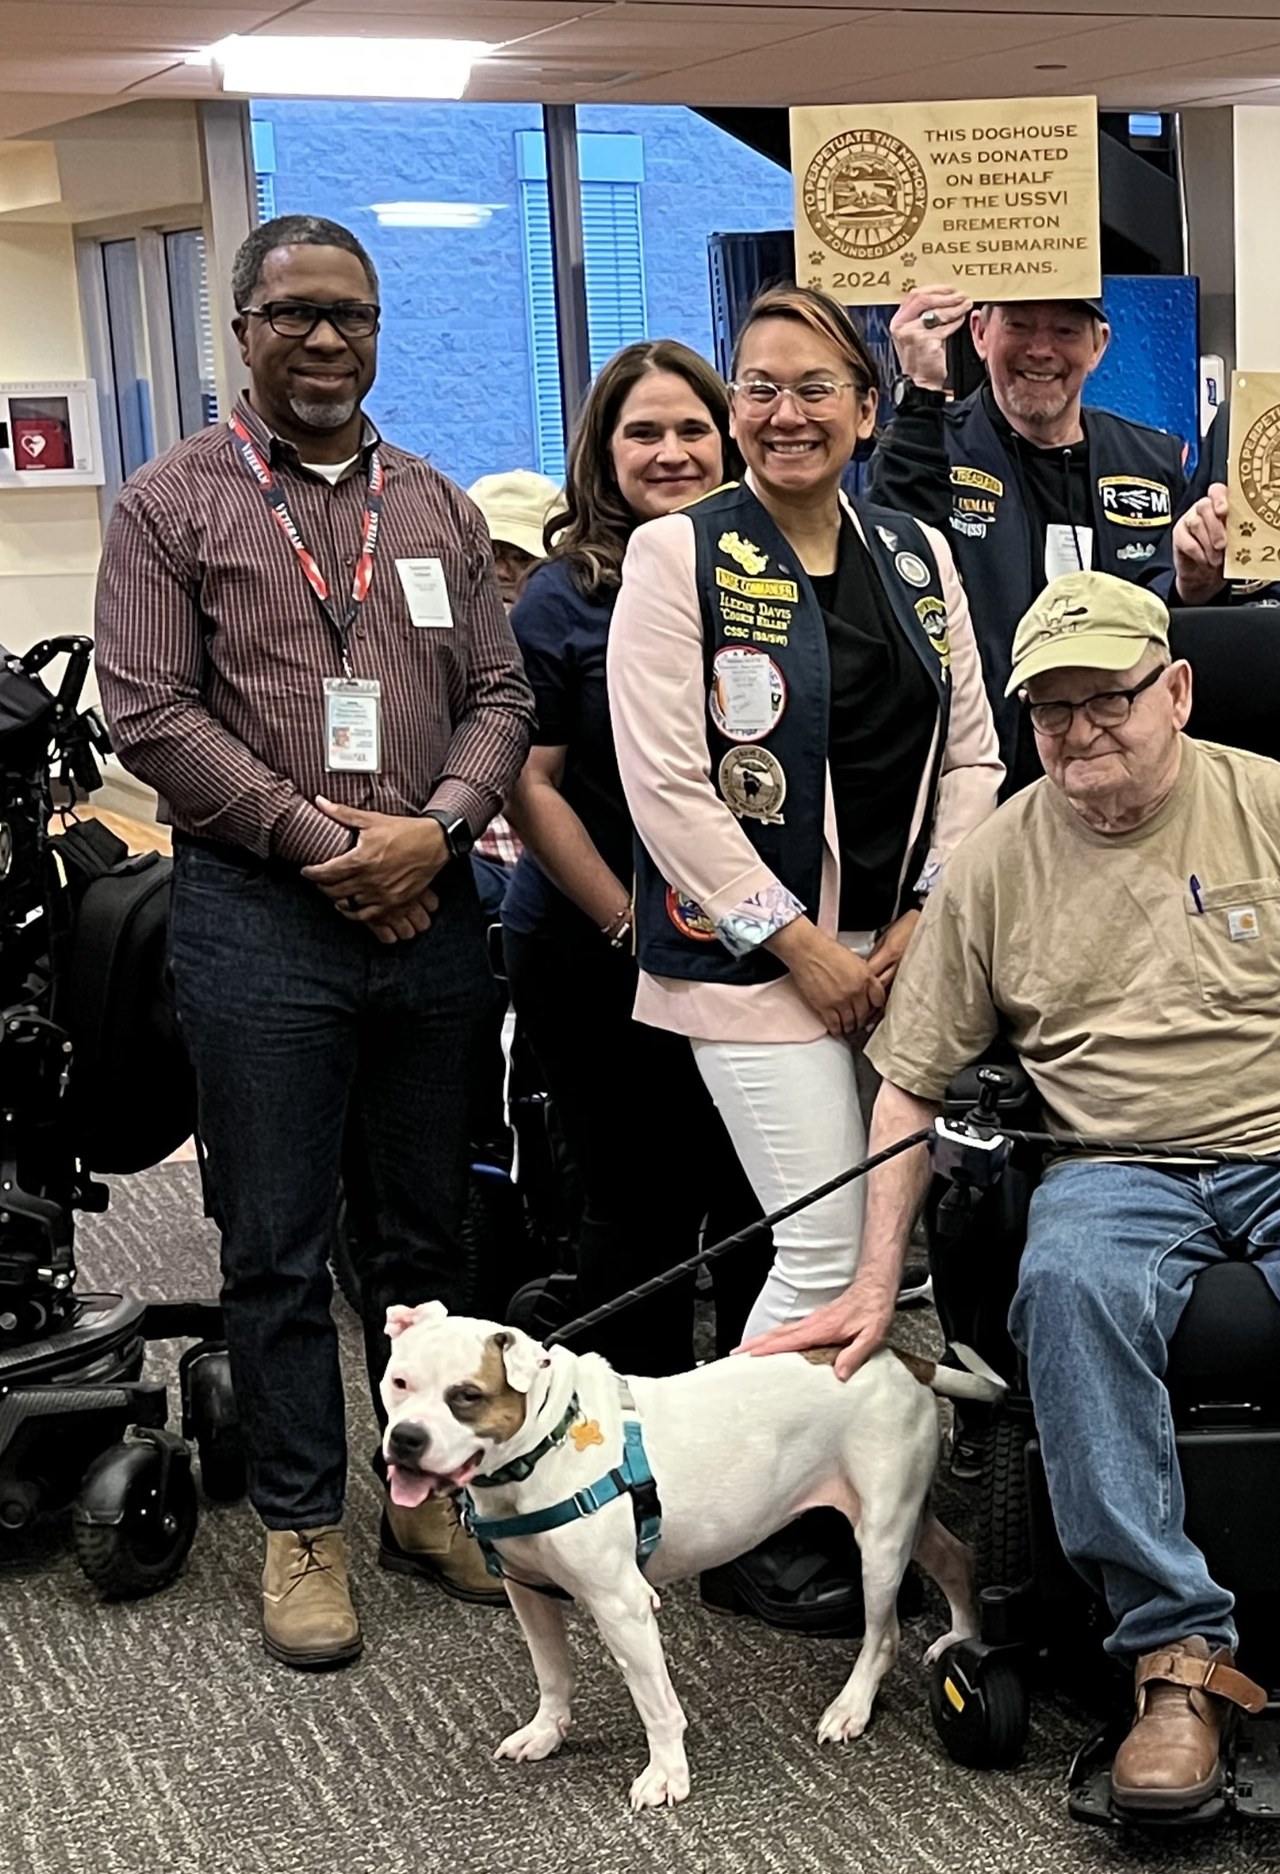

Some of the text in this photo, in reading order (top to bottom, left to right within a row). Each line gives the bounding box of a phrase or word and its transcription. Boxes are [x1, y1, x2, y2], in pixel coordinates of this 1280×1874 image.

[924, 125, 1078, 143] THIS DOGHOUSE
[930, 148, 1068, 165] WAS DONATED
[805, 132, 925, 214] TO PERPETUATE THE MEMORY
[946, 171, 1054, 187] ON BEHALF
[932, 191, 1068, 209] OF THE USSVI
[943, 215, 1060, 231] BREMERTON
[826, 233, 883, 257] FOUNDED
[922, 236, 1088, 254] BASE SUBMARINE
[951, 261, 1058, 276] VETERANS.
[832, 271, 891, 288] 2024
[242, 442, 271, 485] VETERAN
[1240, 462, 1251, 483] TO
[1103, 487, 1168, 513] R M
[275, 503, 306, 549] VETERAN
[362, 510, 379, 553] VETERAN
[758, 602, 792, 619] DAVIS
